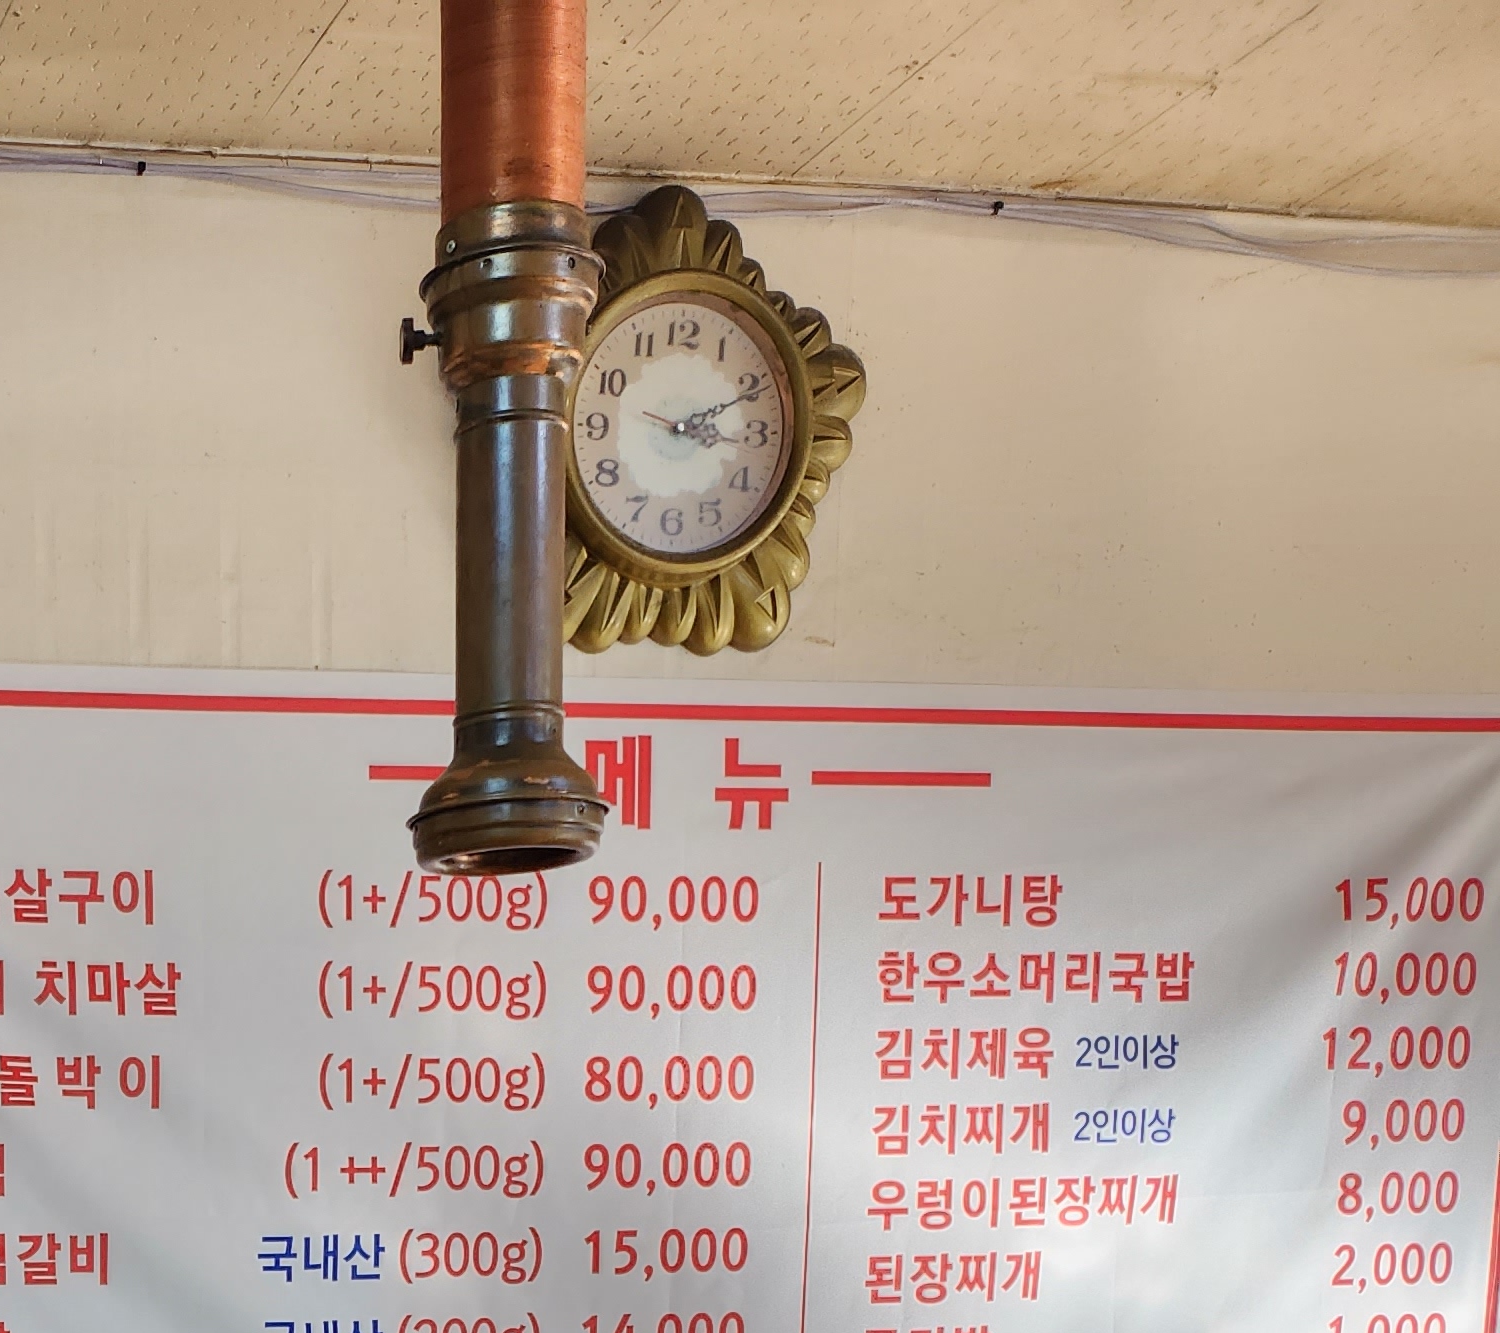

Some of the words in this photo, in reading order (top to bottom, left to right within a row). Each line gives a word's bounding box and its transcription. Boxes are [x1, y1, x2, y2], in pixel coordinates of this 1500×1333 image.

[633, 330, 655, 358] 11
[667, 319, 700, 350] 12
[716, 335, 727, 363] 1
[598, 368, 627, 397] 10
[738, 372, 760, 402] 2
[585, 412, 610, 441] 9
[744, 419, 768, 448] 3
[595, 458, 620, 488] 8
[728, 465, 750, 492] 4
[626, 494, 649, 523] 7
[659, 507, 684, 536] 6
[698, 498, 722, 527] 5
[317, 868, 548, 932] (1+/500g)
[587, 874, 760, 931] 90,000
[877, 873, 1063, 928] 도가니탕
[1335, 875, 1485, 929] 15,000
[34, 959, 182, 1017] 치마살
[318, 960, 547, 1021] (1+/500g)
[586, 963, 757, 1019] 90,000
[877, 950, 1196, 1004] 한우소머리국밥
[1333, 951, 1477, 1004] 10,000
[874, 1026, 1055, 1081] 김치제육
[1074, 1034, 1180, 1069] 2인이상
[1322, 1024, 1471, 1077] 12,000
[318, 1052, 546, 1112] (1+/500g)
[583, 1054, 755, 1109] 80,000
[871, 1102, 1050, 1156] 김치찌개
[1073, 1108, 1177, 1143] 2인이상
[1342, 1098, 1465, 1149] 9,000
[583, 1140, 752, 1195] 90,000
[866, 1174, 1179, 1232] 우렁이된장찌개
[1336, 1170, 1459, 1222] 8,000
[257, 1233, 386, 1282] 국내산
[399, 1227, 543, 1284] (300g)
[584, 1226, 750, 1281] 15,000
[864, 1251, 1042, 1305] 된장찌개
[1331, 1242, 1453, 1293] 2,000
